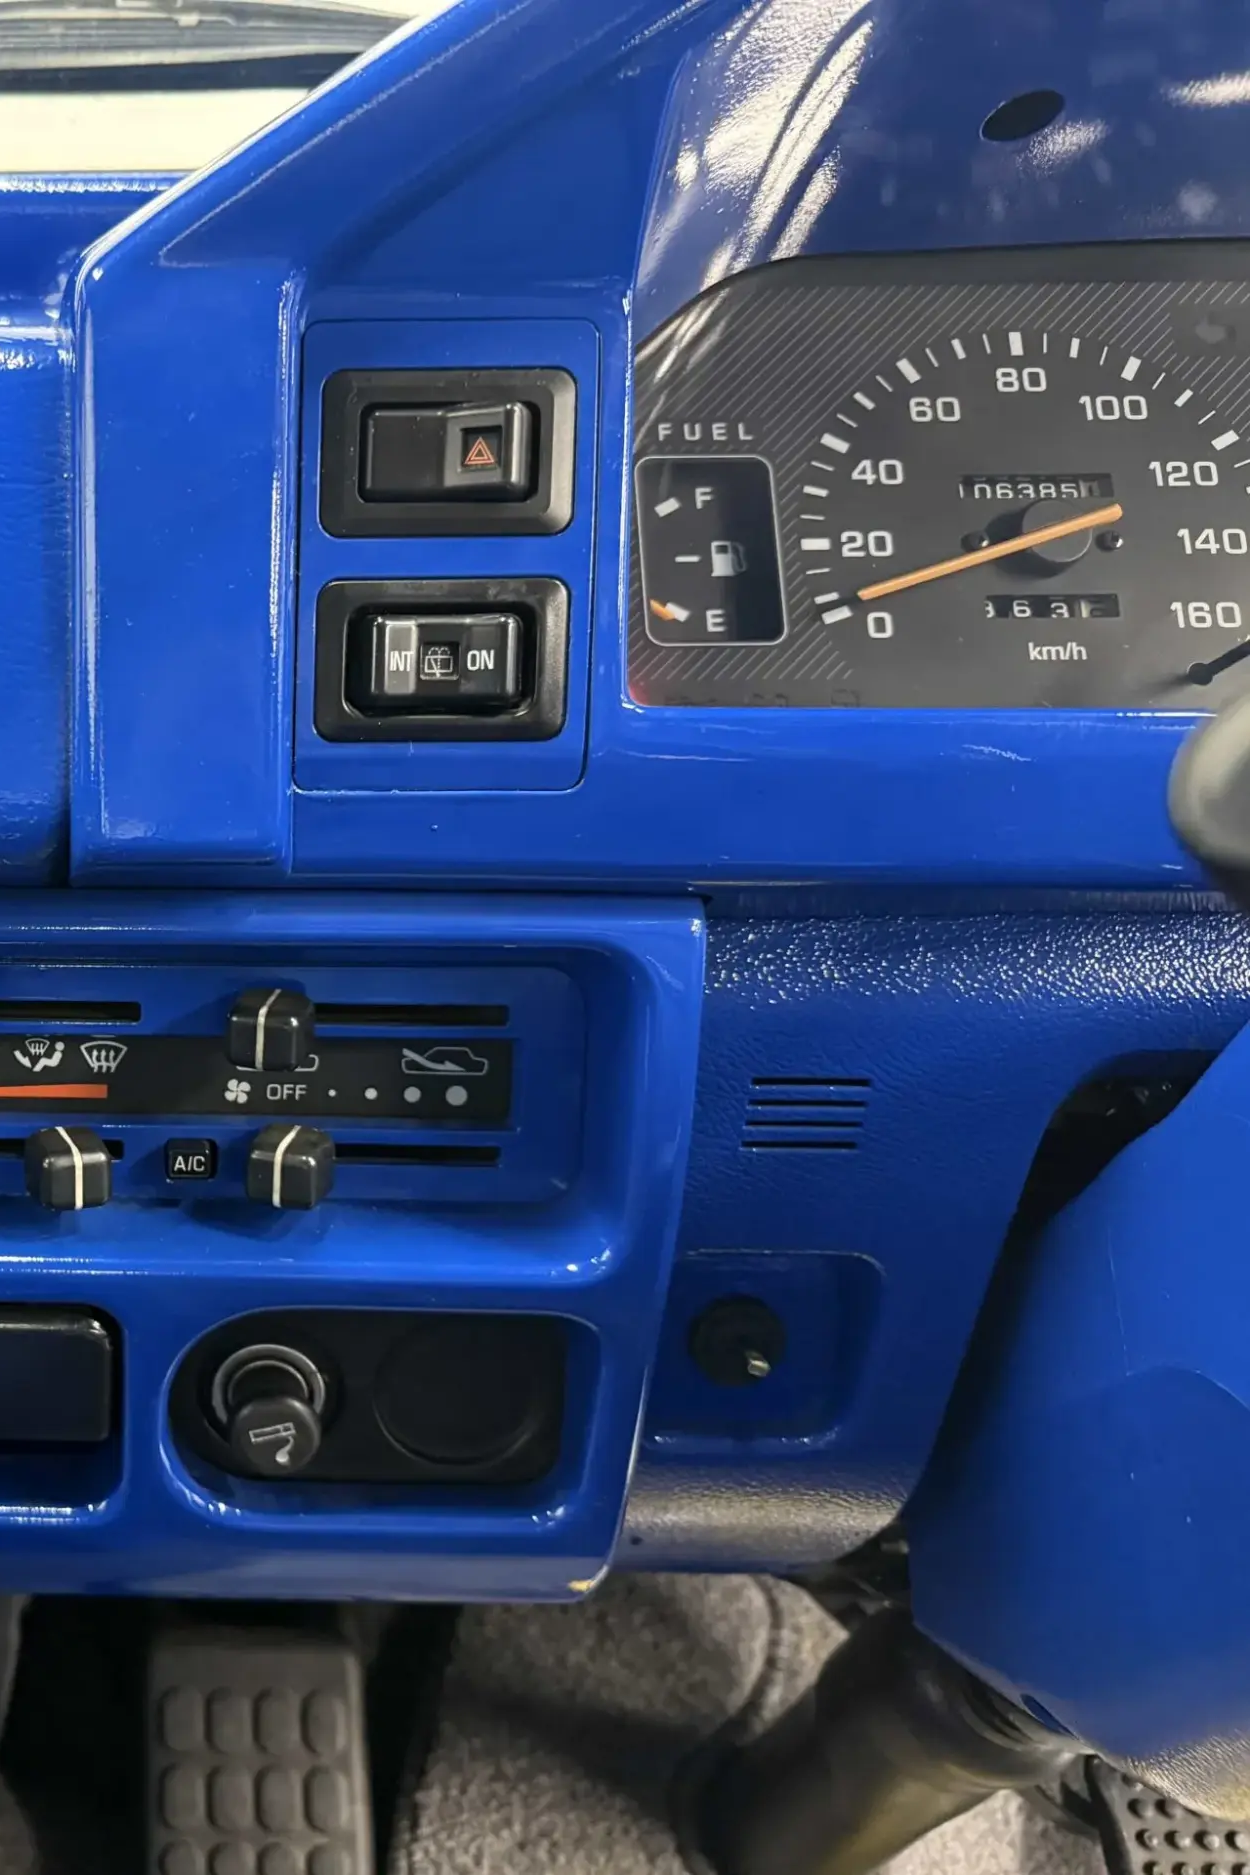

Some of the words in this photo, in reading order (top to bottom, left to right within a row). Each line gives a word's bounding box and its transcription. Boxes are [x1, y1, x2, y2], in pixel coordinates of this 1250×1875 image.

[995, 366, 1047, 394] 80
[908, 396, 961, 423] 60
[1079, 395, 1147, 421] 100
[658, 422, 753, 441] FUEL
[851, 459, 904, 484] 40
[1149, 461, 1219, 487] 120
[694, 486, 714, 509] F
[840, 530, 894, 557] 20
[1177, 528, 1247, 554] 140
[705, 609, 727, 632] E
[867, 612, 893, 638] 0
[1170, 601, 1242, 628] 160
[390, 651, 414, 671] INT
[467, 650, 494, 670] ON
[1028, 641, 1088, 663] km/h
[266, 1083, 307, 1101] OFF
[173, 1155, 205, 1172] A/C
